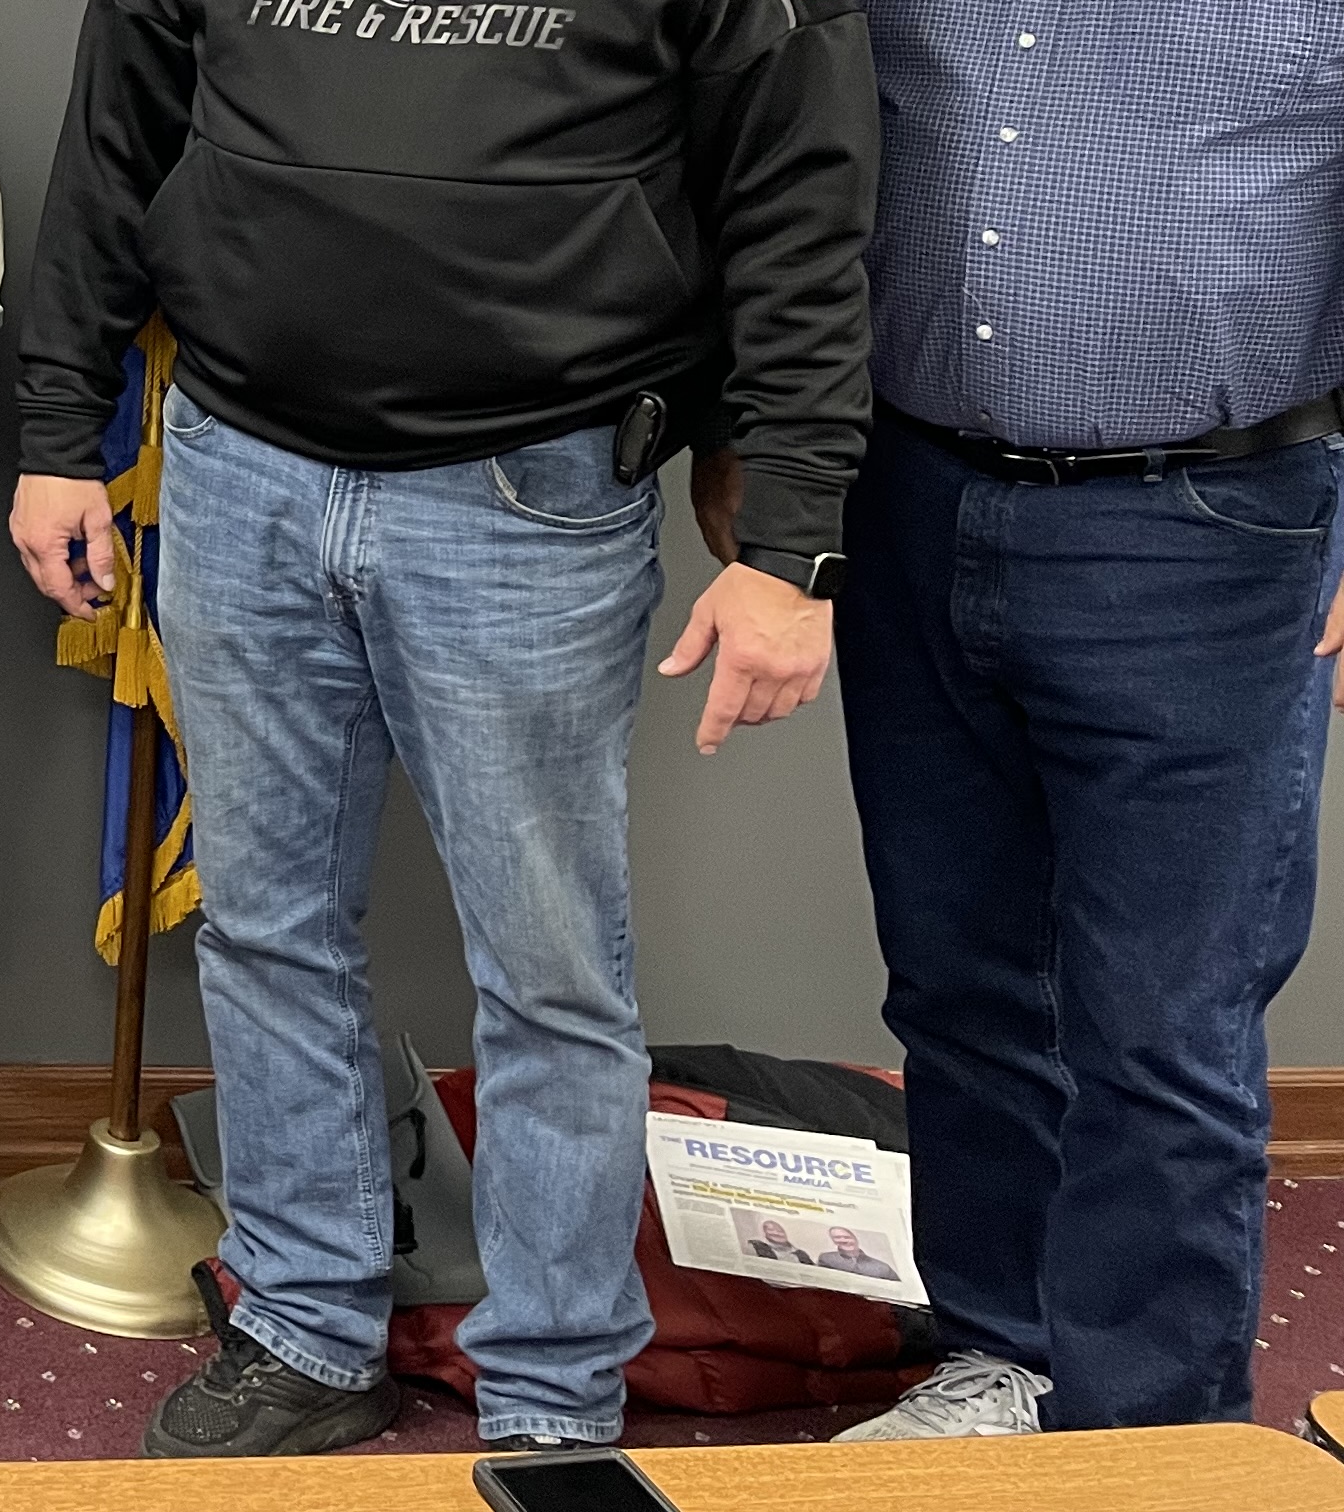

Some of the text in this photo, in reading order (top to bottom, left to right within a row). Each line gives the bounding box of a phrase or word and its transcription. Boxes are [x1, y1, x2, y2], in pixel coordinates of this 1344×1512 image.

[356, 5, 385, 39] &
[390, 3, 577, 50] RESCUE
[684, 1138, 875, 1184] RESOURCE
